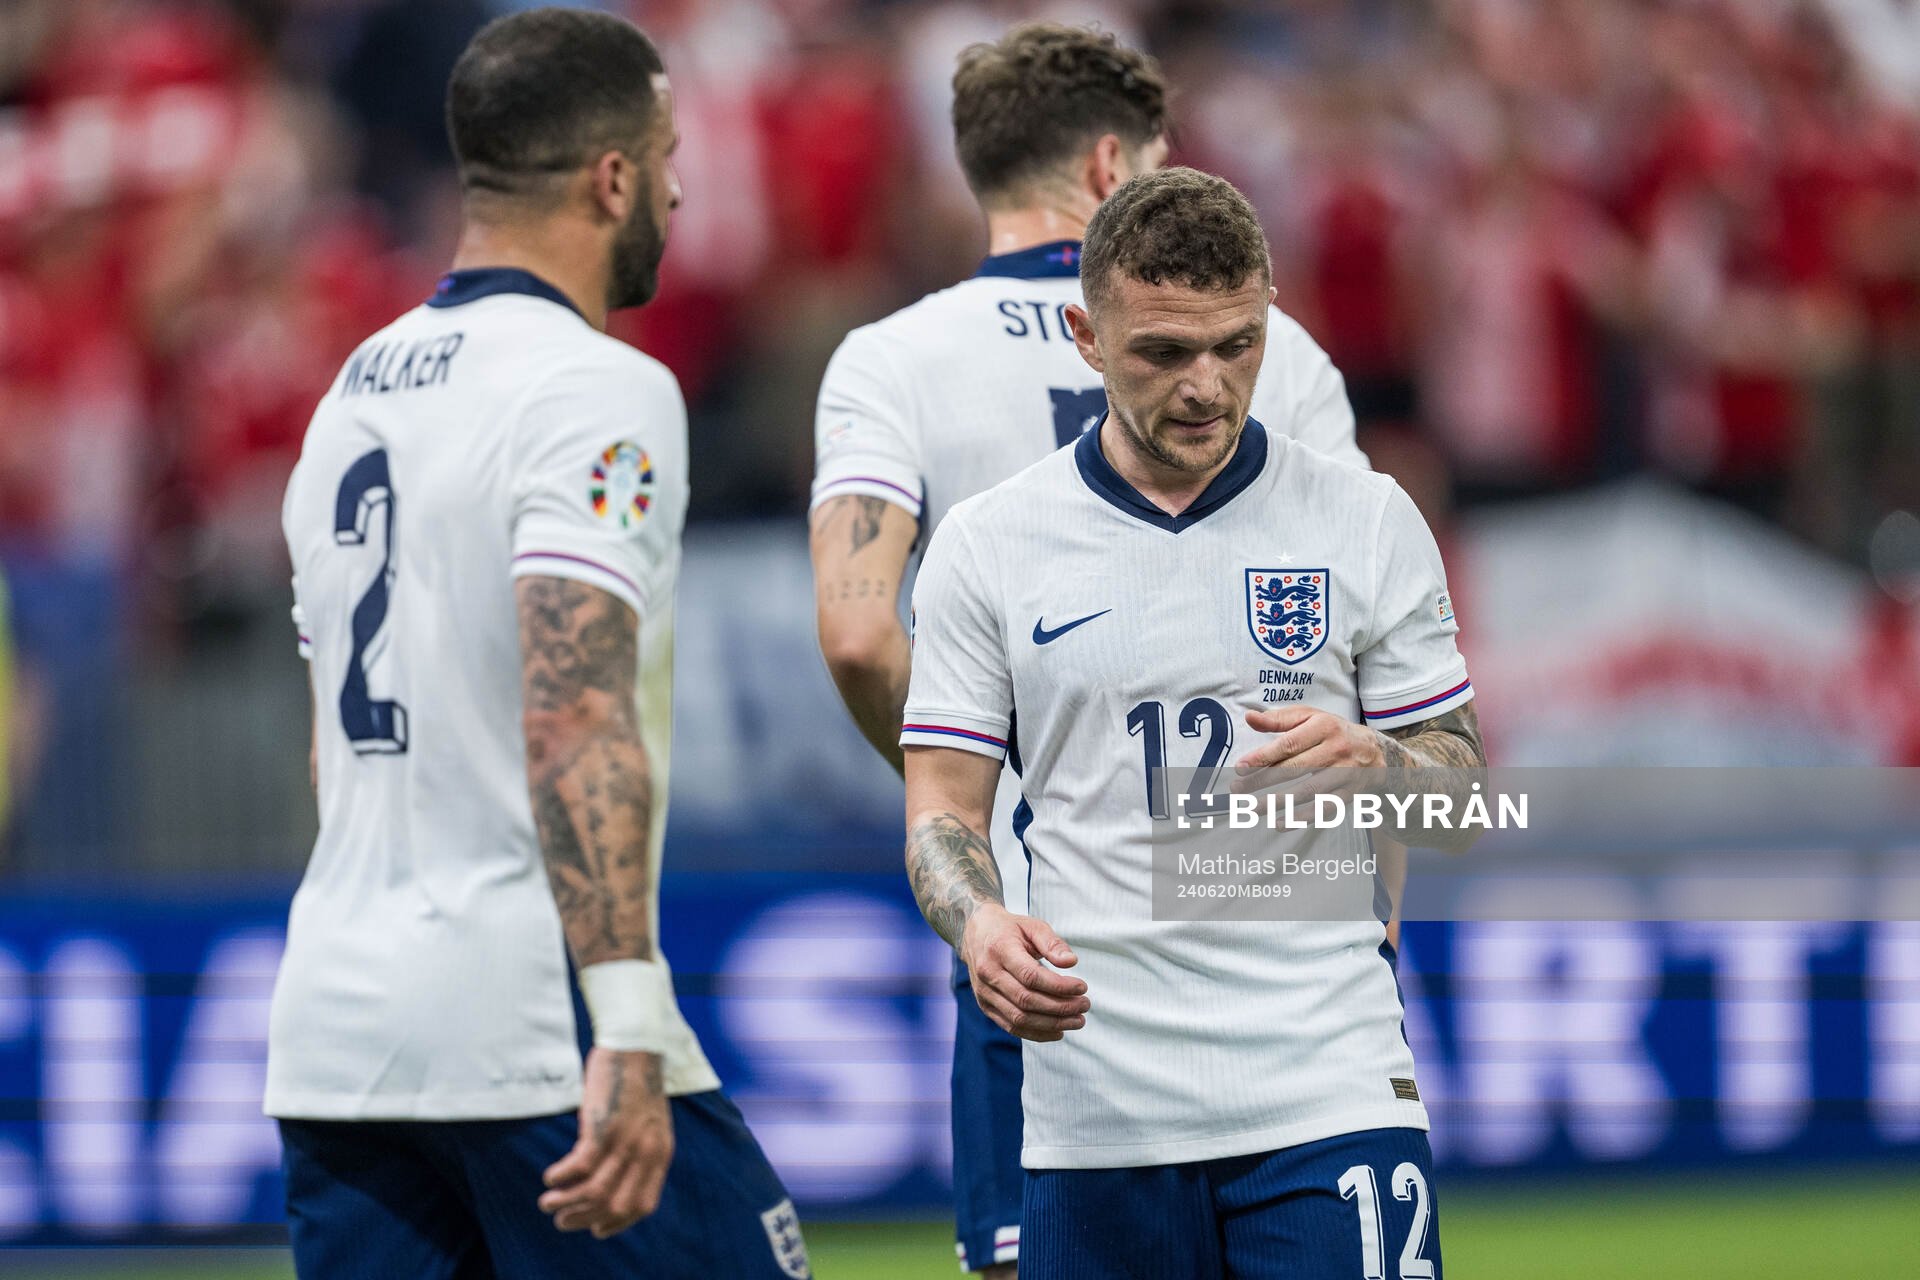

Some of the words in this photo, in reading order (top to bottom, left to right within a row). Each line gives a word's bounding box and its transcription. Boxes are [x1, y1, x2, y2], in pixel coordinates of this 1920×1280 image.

[997, 299, 1074, 342] STO
[341, 332, 464, 399] WALKER
[335, 446, 408, 755] 2
[1259, 669, 1314, 686] DENMARK
[1262, 688, 1305, 703] 20.06.24
[1126, 697, 1236, 820] 12
[1337, 1162, 1435, 1280] 12
